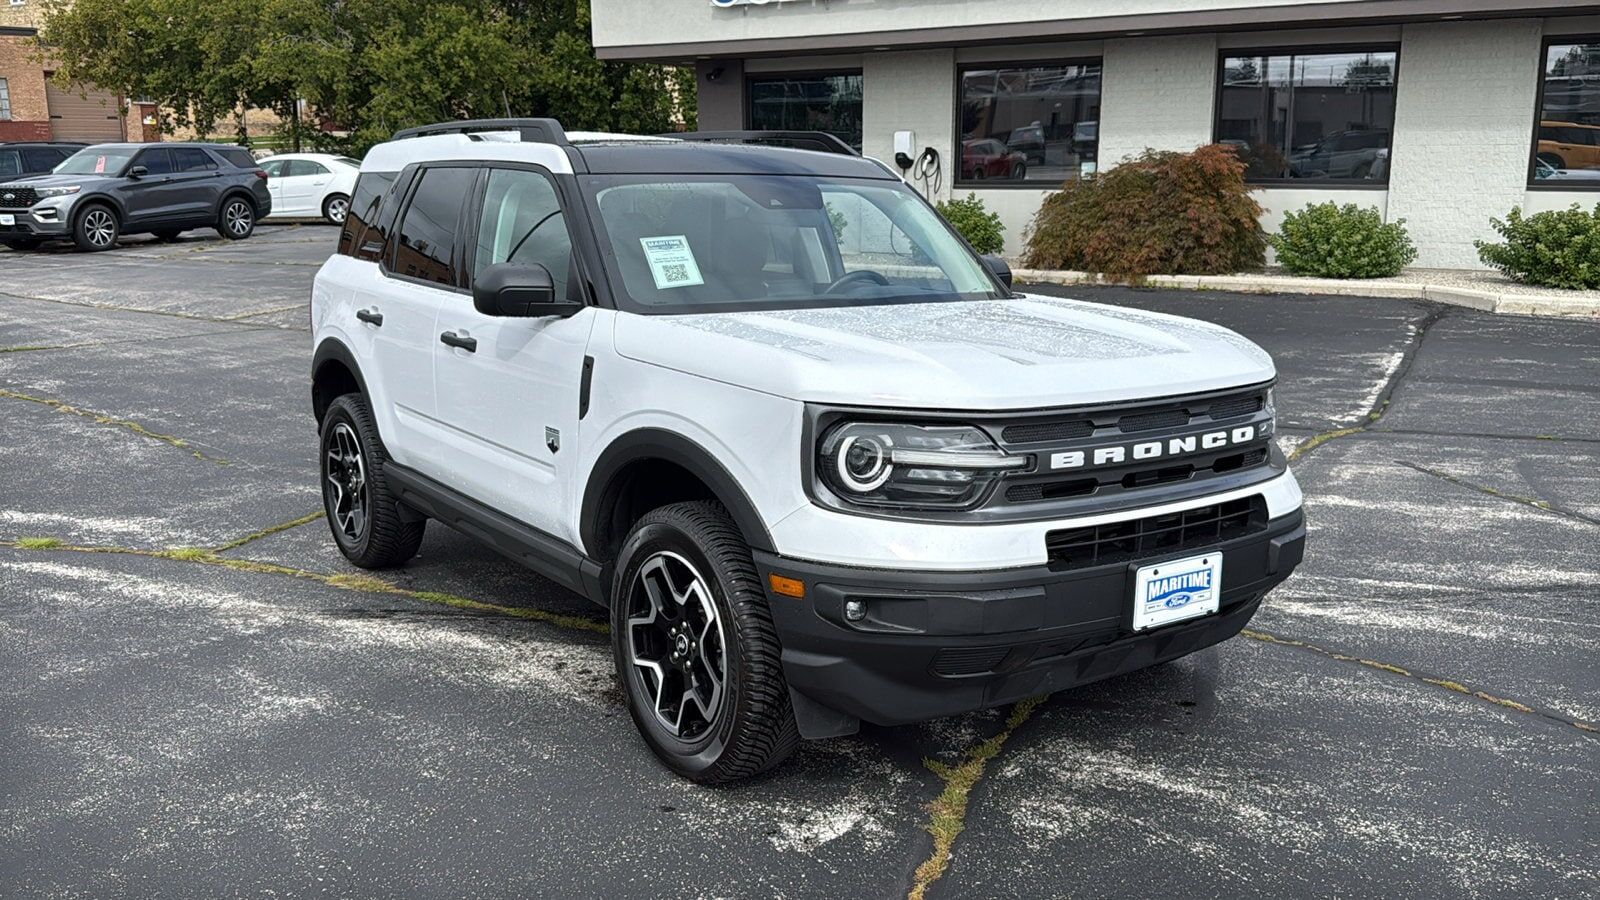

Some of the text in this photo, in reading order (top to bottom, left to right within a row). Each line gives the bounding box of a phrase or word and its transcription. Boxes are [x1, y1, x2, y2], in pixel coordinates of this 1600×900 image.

[1051, 426, 1254, 469] BRONCO
[1148, 570, 1210, 601] MARITIME
[1167, 596, 1188, 607] Ford
